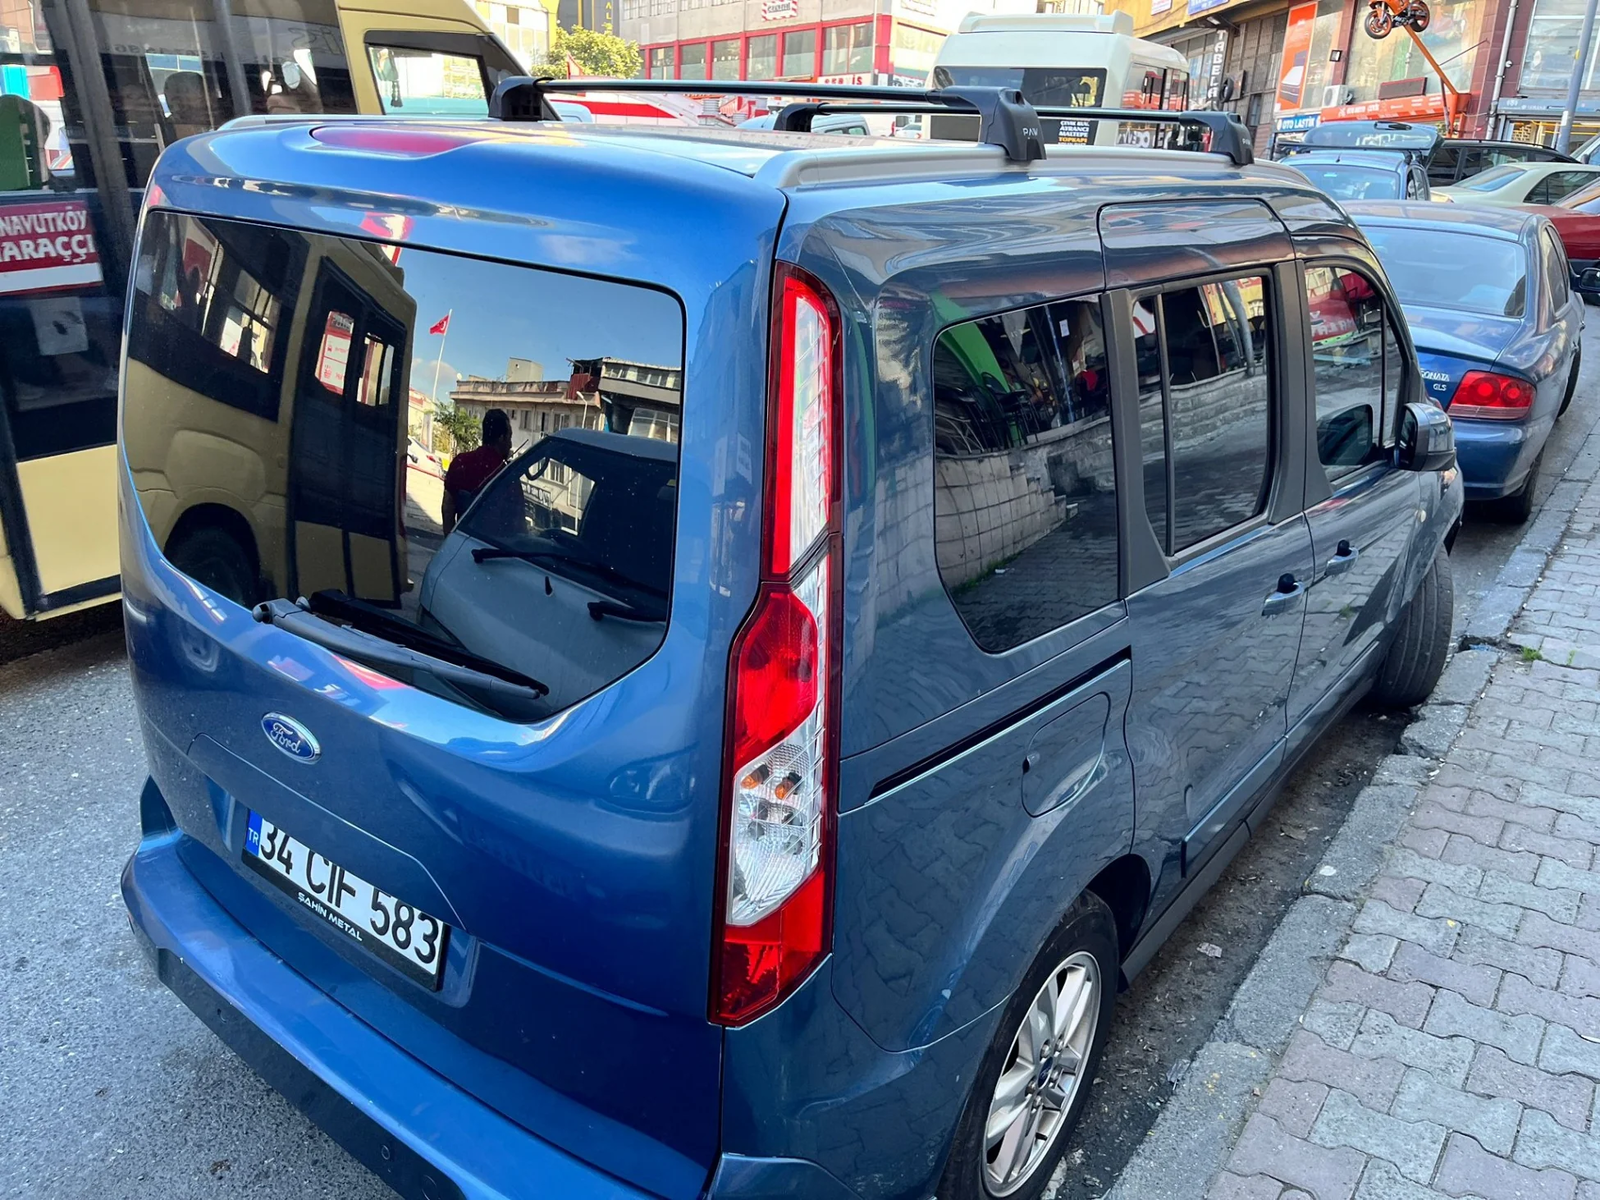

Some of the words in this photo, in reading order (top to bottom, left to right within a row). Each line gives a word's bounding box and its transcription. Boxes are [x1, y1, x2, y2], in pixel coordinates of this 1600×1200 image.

[1208, 29, 1227, 98] TABELA
[1282, 119, 1294, 130] OTO
[1294, 115, 1315, 129] LASTİK
[0, 234, 96, 263] ARAÇÇI
[1420, 370, 1449, 382] SONATA
[1432, 383, 1447, 392] GLS
[270, 722, 301, 754] Ford
[248, 827, 259, 846] TR
[260, 825, 293, 876] 34
[306, 849, 356, 909] CIF
[370, 887, 440, 965] 583
[297, 891, 327, 918] ŞAHİN
[328, 912, 363, 942] METAL
